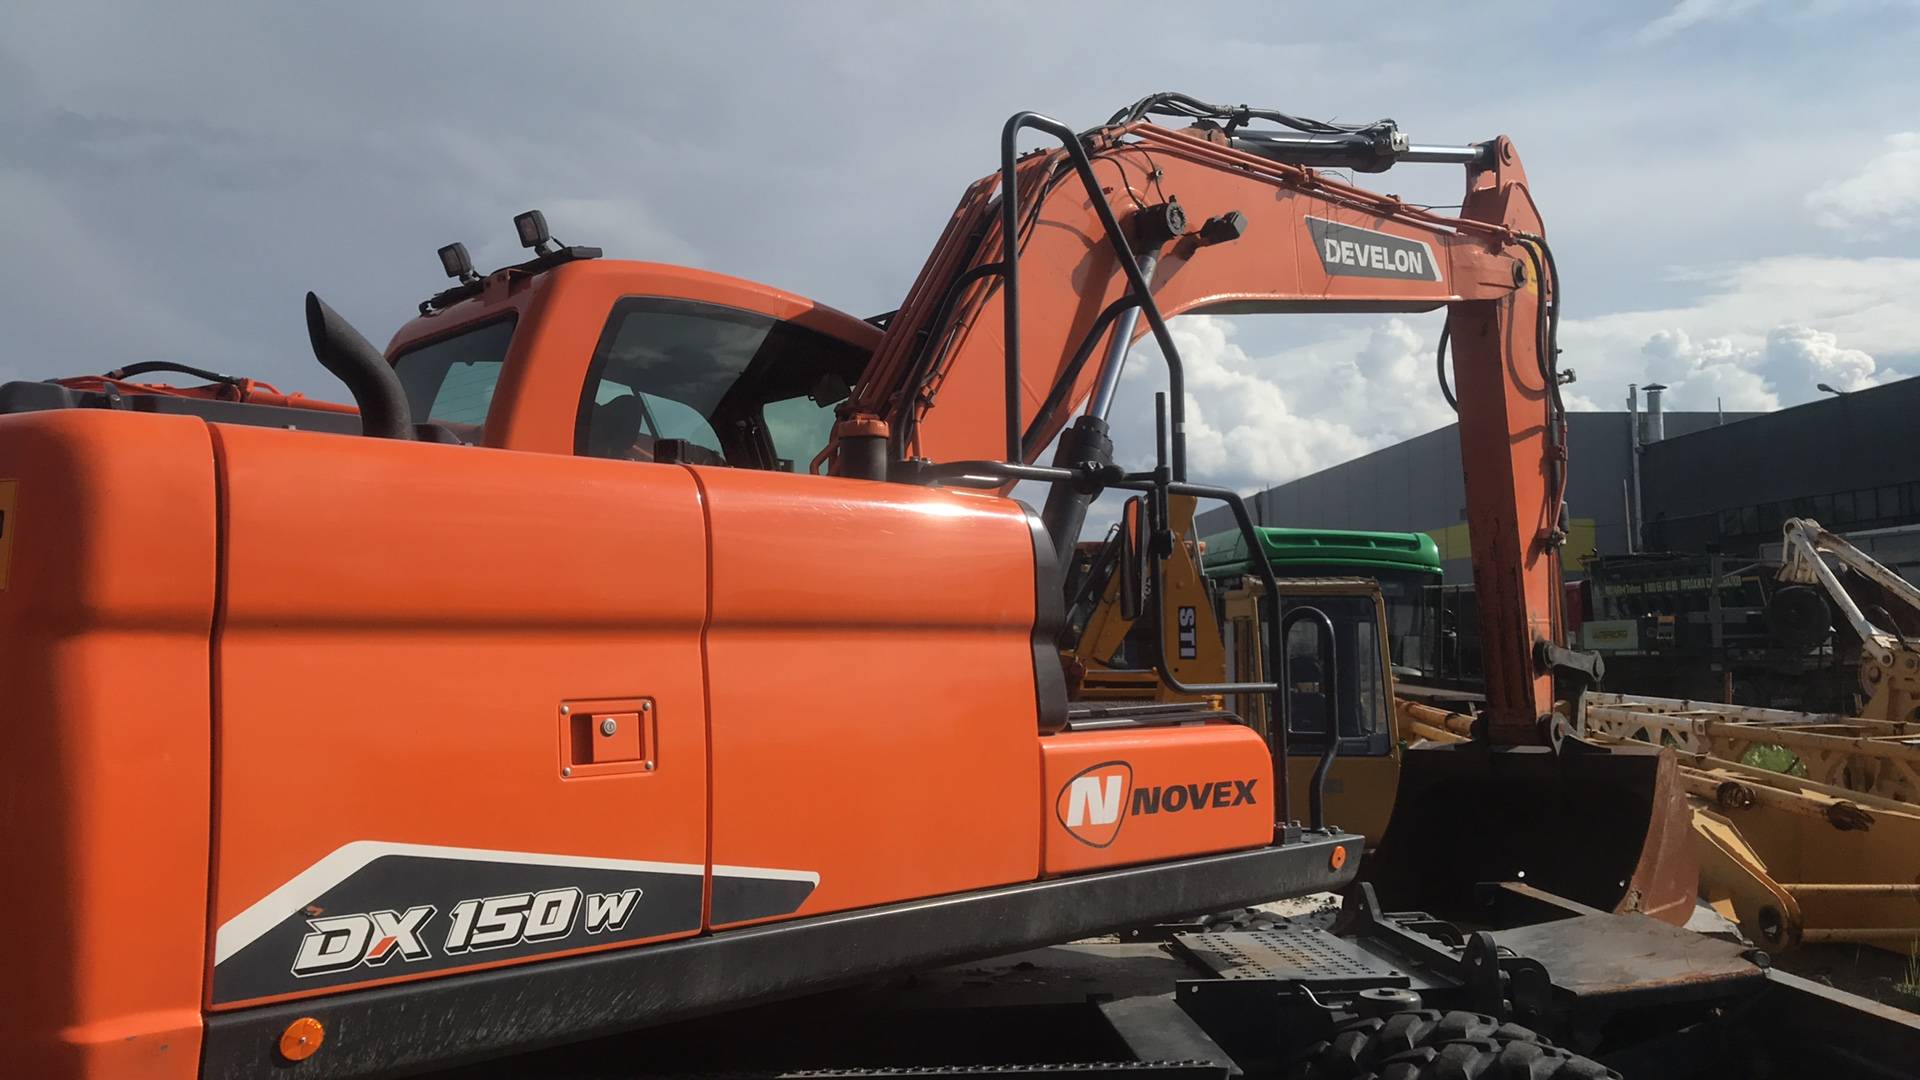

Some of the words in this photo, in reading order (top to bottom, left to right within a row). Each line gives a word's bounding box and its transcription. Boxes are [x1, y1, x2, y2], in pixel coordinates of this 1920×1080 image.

[1324, 238, 1423, 274] DEVELON
[1180, 608, 1195, 656] STI
[1066, 775, 1122, 827] N
[1131, 779, 1258, 816] NOVEX
[291, 905, 437, 978] DX
[443, 887, 583, 956] 150
